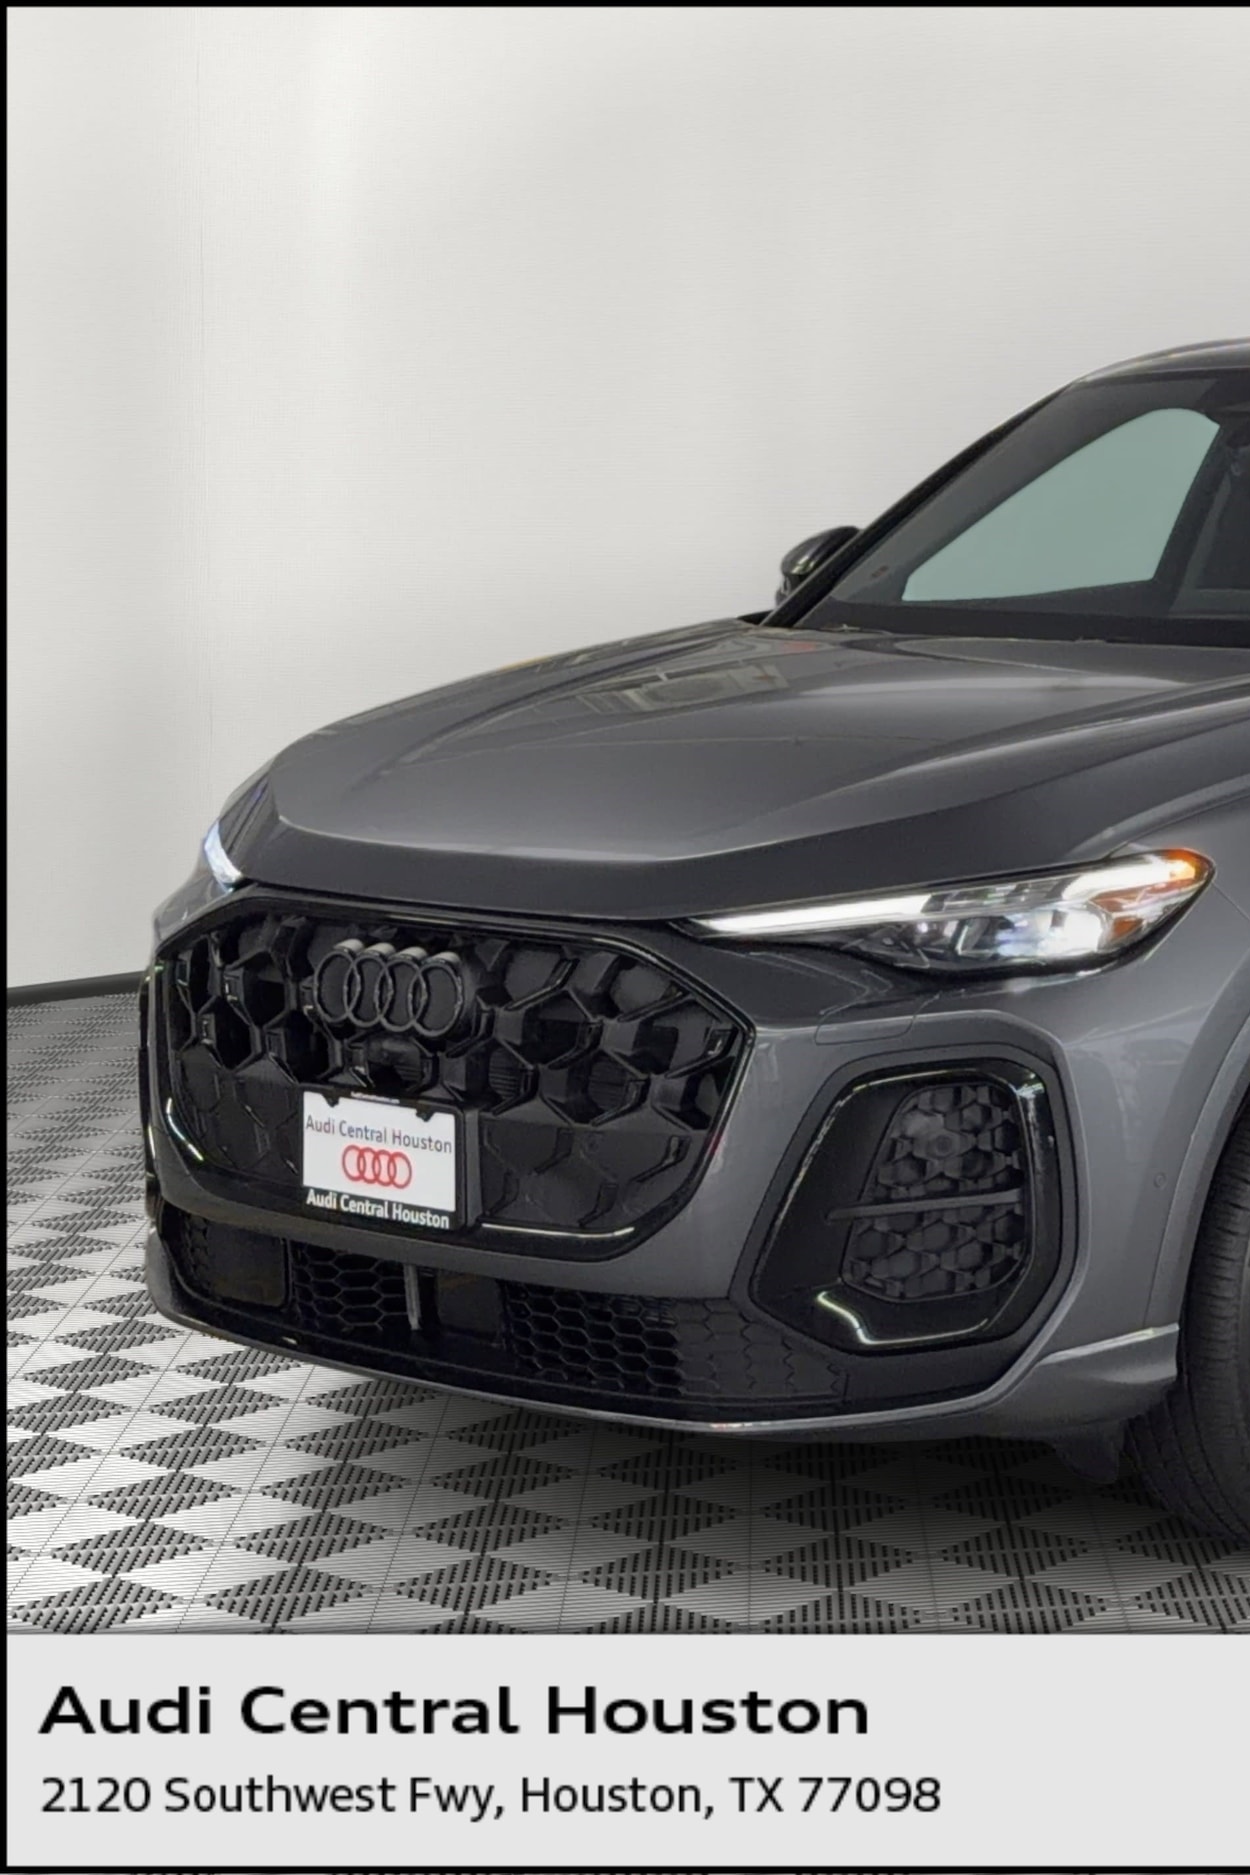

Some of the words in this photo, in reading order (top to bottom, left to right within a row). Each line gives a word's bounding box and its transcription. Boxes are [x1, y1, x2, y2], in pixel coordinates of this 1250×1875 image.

[305, 1114, 335, 1138] Audi
[339, 1120, 387, 1143] Central
[392, 1129, 452, 1153] Houston
[306, 1189, 337, 1210] Audi
[340, 1194, 389, 1219] Central
[392, 1204, 450, 1229] Houston
